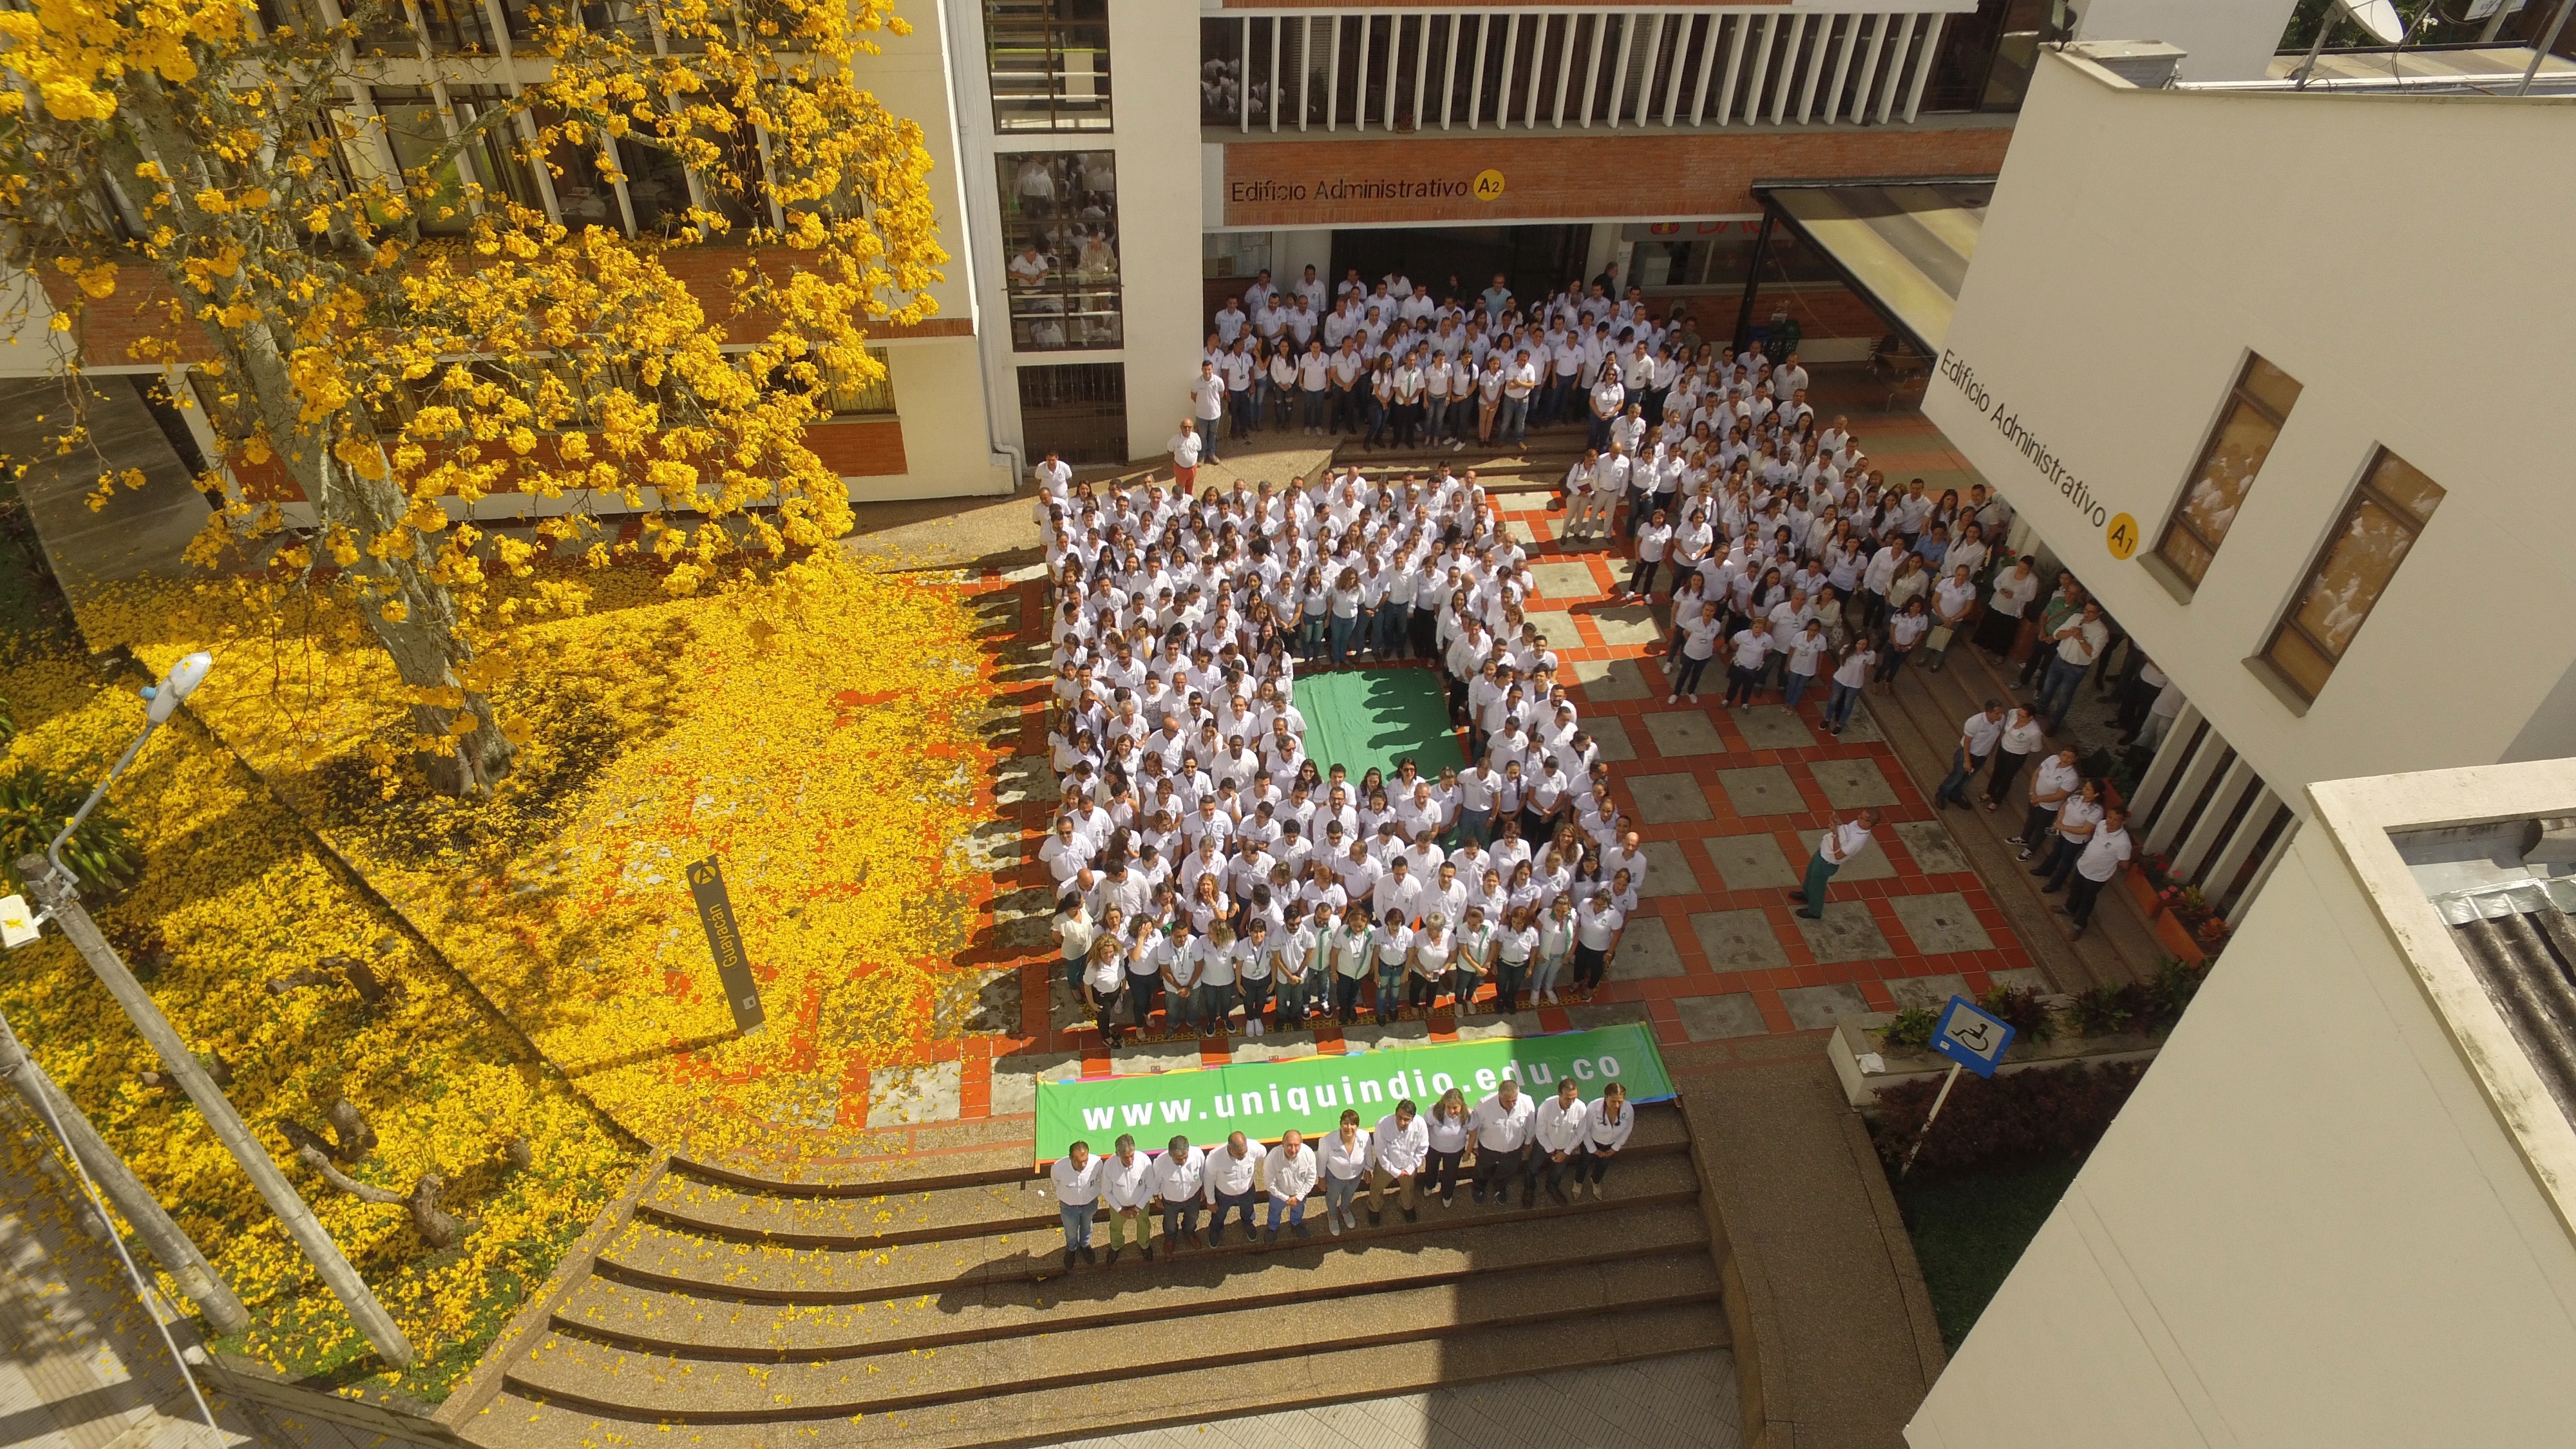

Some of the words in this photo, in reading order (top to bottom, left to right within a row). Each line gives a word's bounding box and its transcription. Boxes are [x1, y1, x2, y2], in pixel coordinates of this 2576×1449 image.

[1232, 180, 1307, 202] Edificio
[1314, 178, 1468, 200] Administrativo
[1477, 177, 1500, 193] A2
[1940, 348, 1991, 412] Edificio
[1990, 402, 2107, 527] Administrativo
[2110, 524, 2134, 554] A1
[699, 866, 715, 885] A
[707, 903, 739, 968] Guayacán
[1081, 1055, 1621, 1131] www.uniquindio.edu.co
